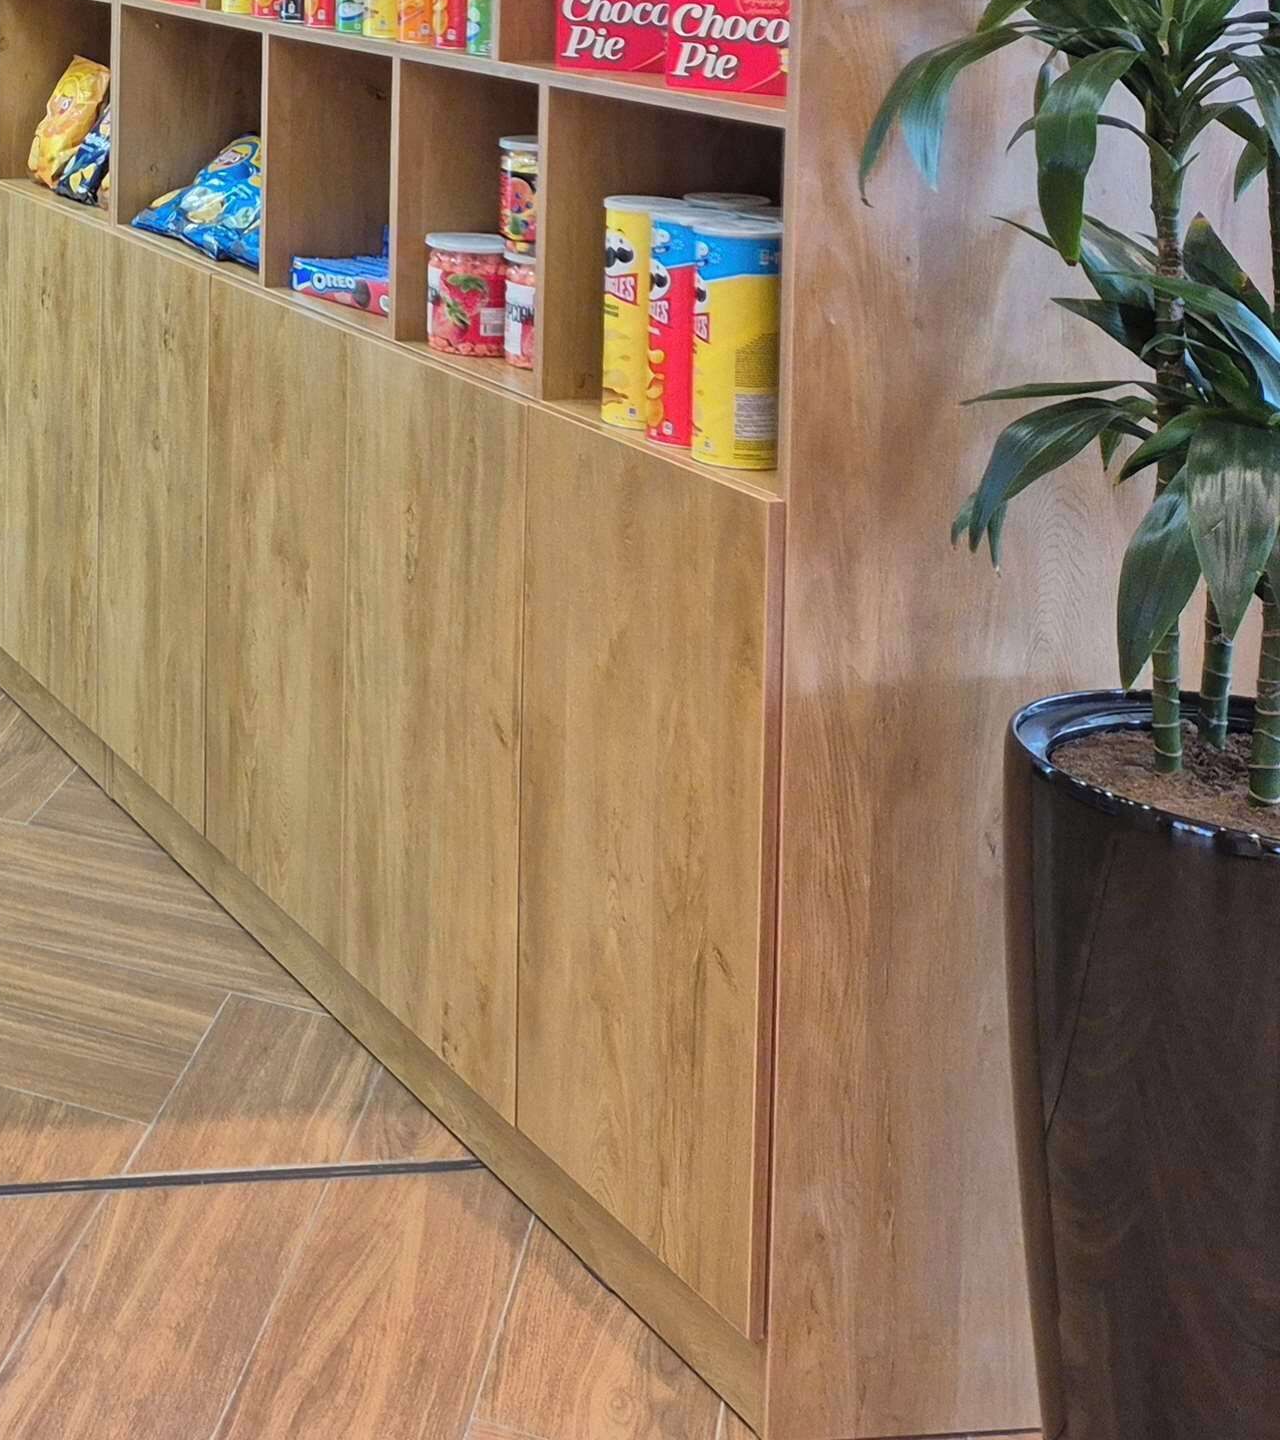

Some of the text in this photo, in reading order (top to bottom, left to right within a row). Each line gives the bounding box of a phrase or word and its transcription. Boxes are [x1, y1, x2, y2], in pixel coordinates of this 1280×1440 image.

[671, 3, 790, 43] Choco
[561, 25, 625, 59] Pie
[671, 41, 738, 79] Pie
[312, 272, 356, 290] OREO
